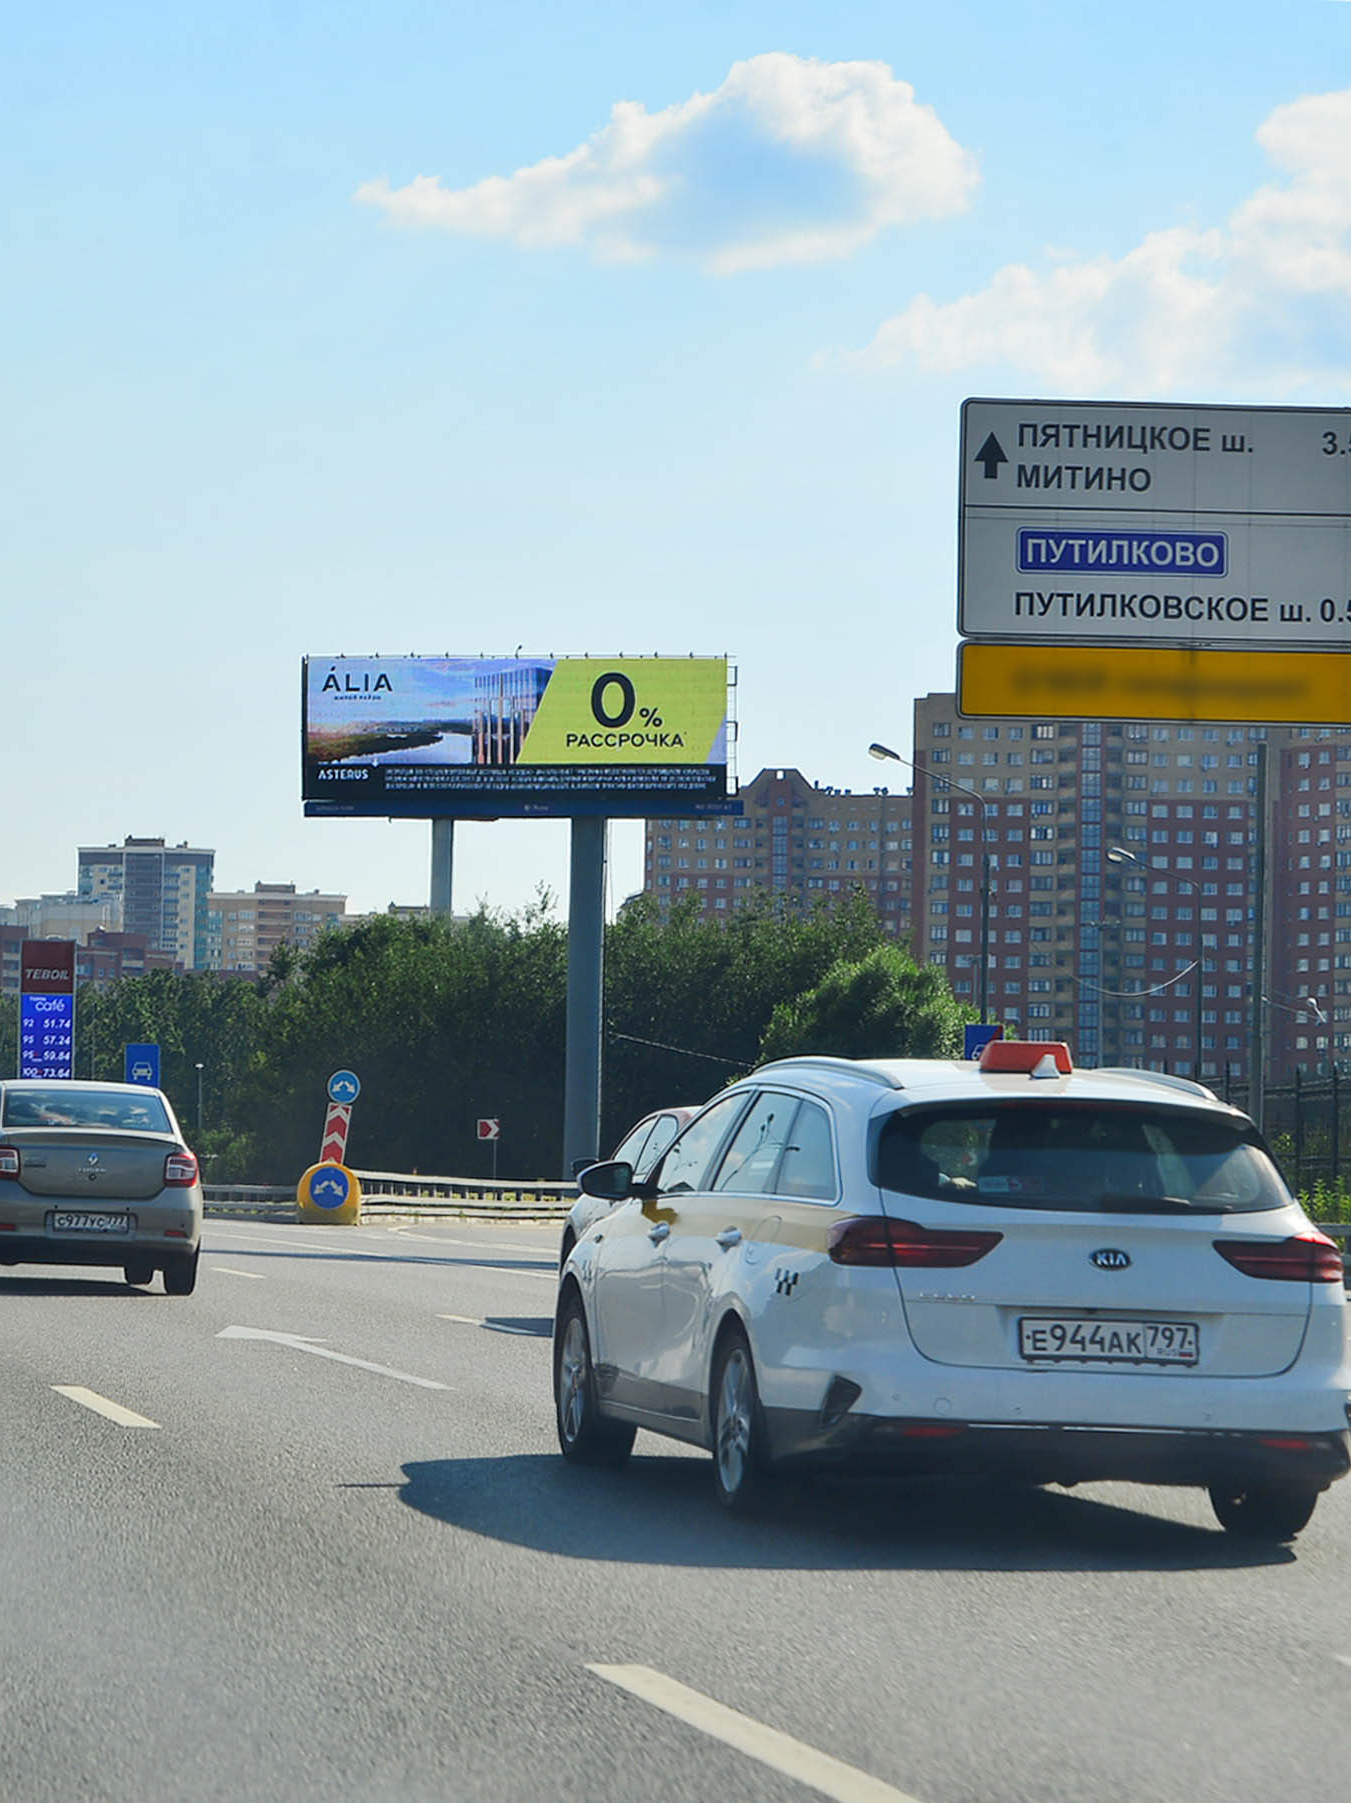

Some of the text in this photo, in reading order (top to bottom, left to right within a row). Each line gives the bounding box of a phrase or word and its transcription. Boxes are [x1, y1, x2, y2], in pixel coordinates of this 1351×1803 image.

[1018, 423, 1254, 454] ПЯТНИЦКОЕ ш.
[1321, 431, 1351, 456] 3.
[1017, 464, 1151, 492] МИТИНО
[1026, 537, 1220, 568] ПУТИЛКОВО
[1014, 591, 1312, 623] ПУТИЛКОВСКОЕ ш.
[322, 666, 393, 692] ÁLIA
[318, 769, 369, 780] ASTERUS
[25, 969, 69, 980] TEBOIL
[43, 1018, 71, 1029] 51.74
[43, 1034, 71, 1046] 57.24
[1096, 1252, 1128, 1266] KIA
